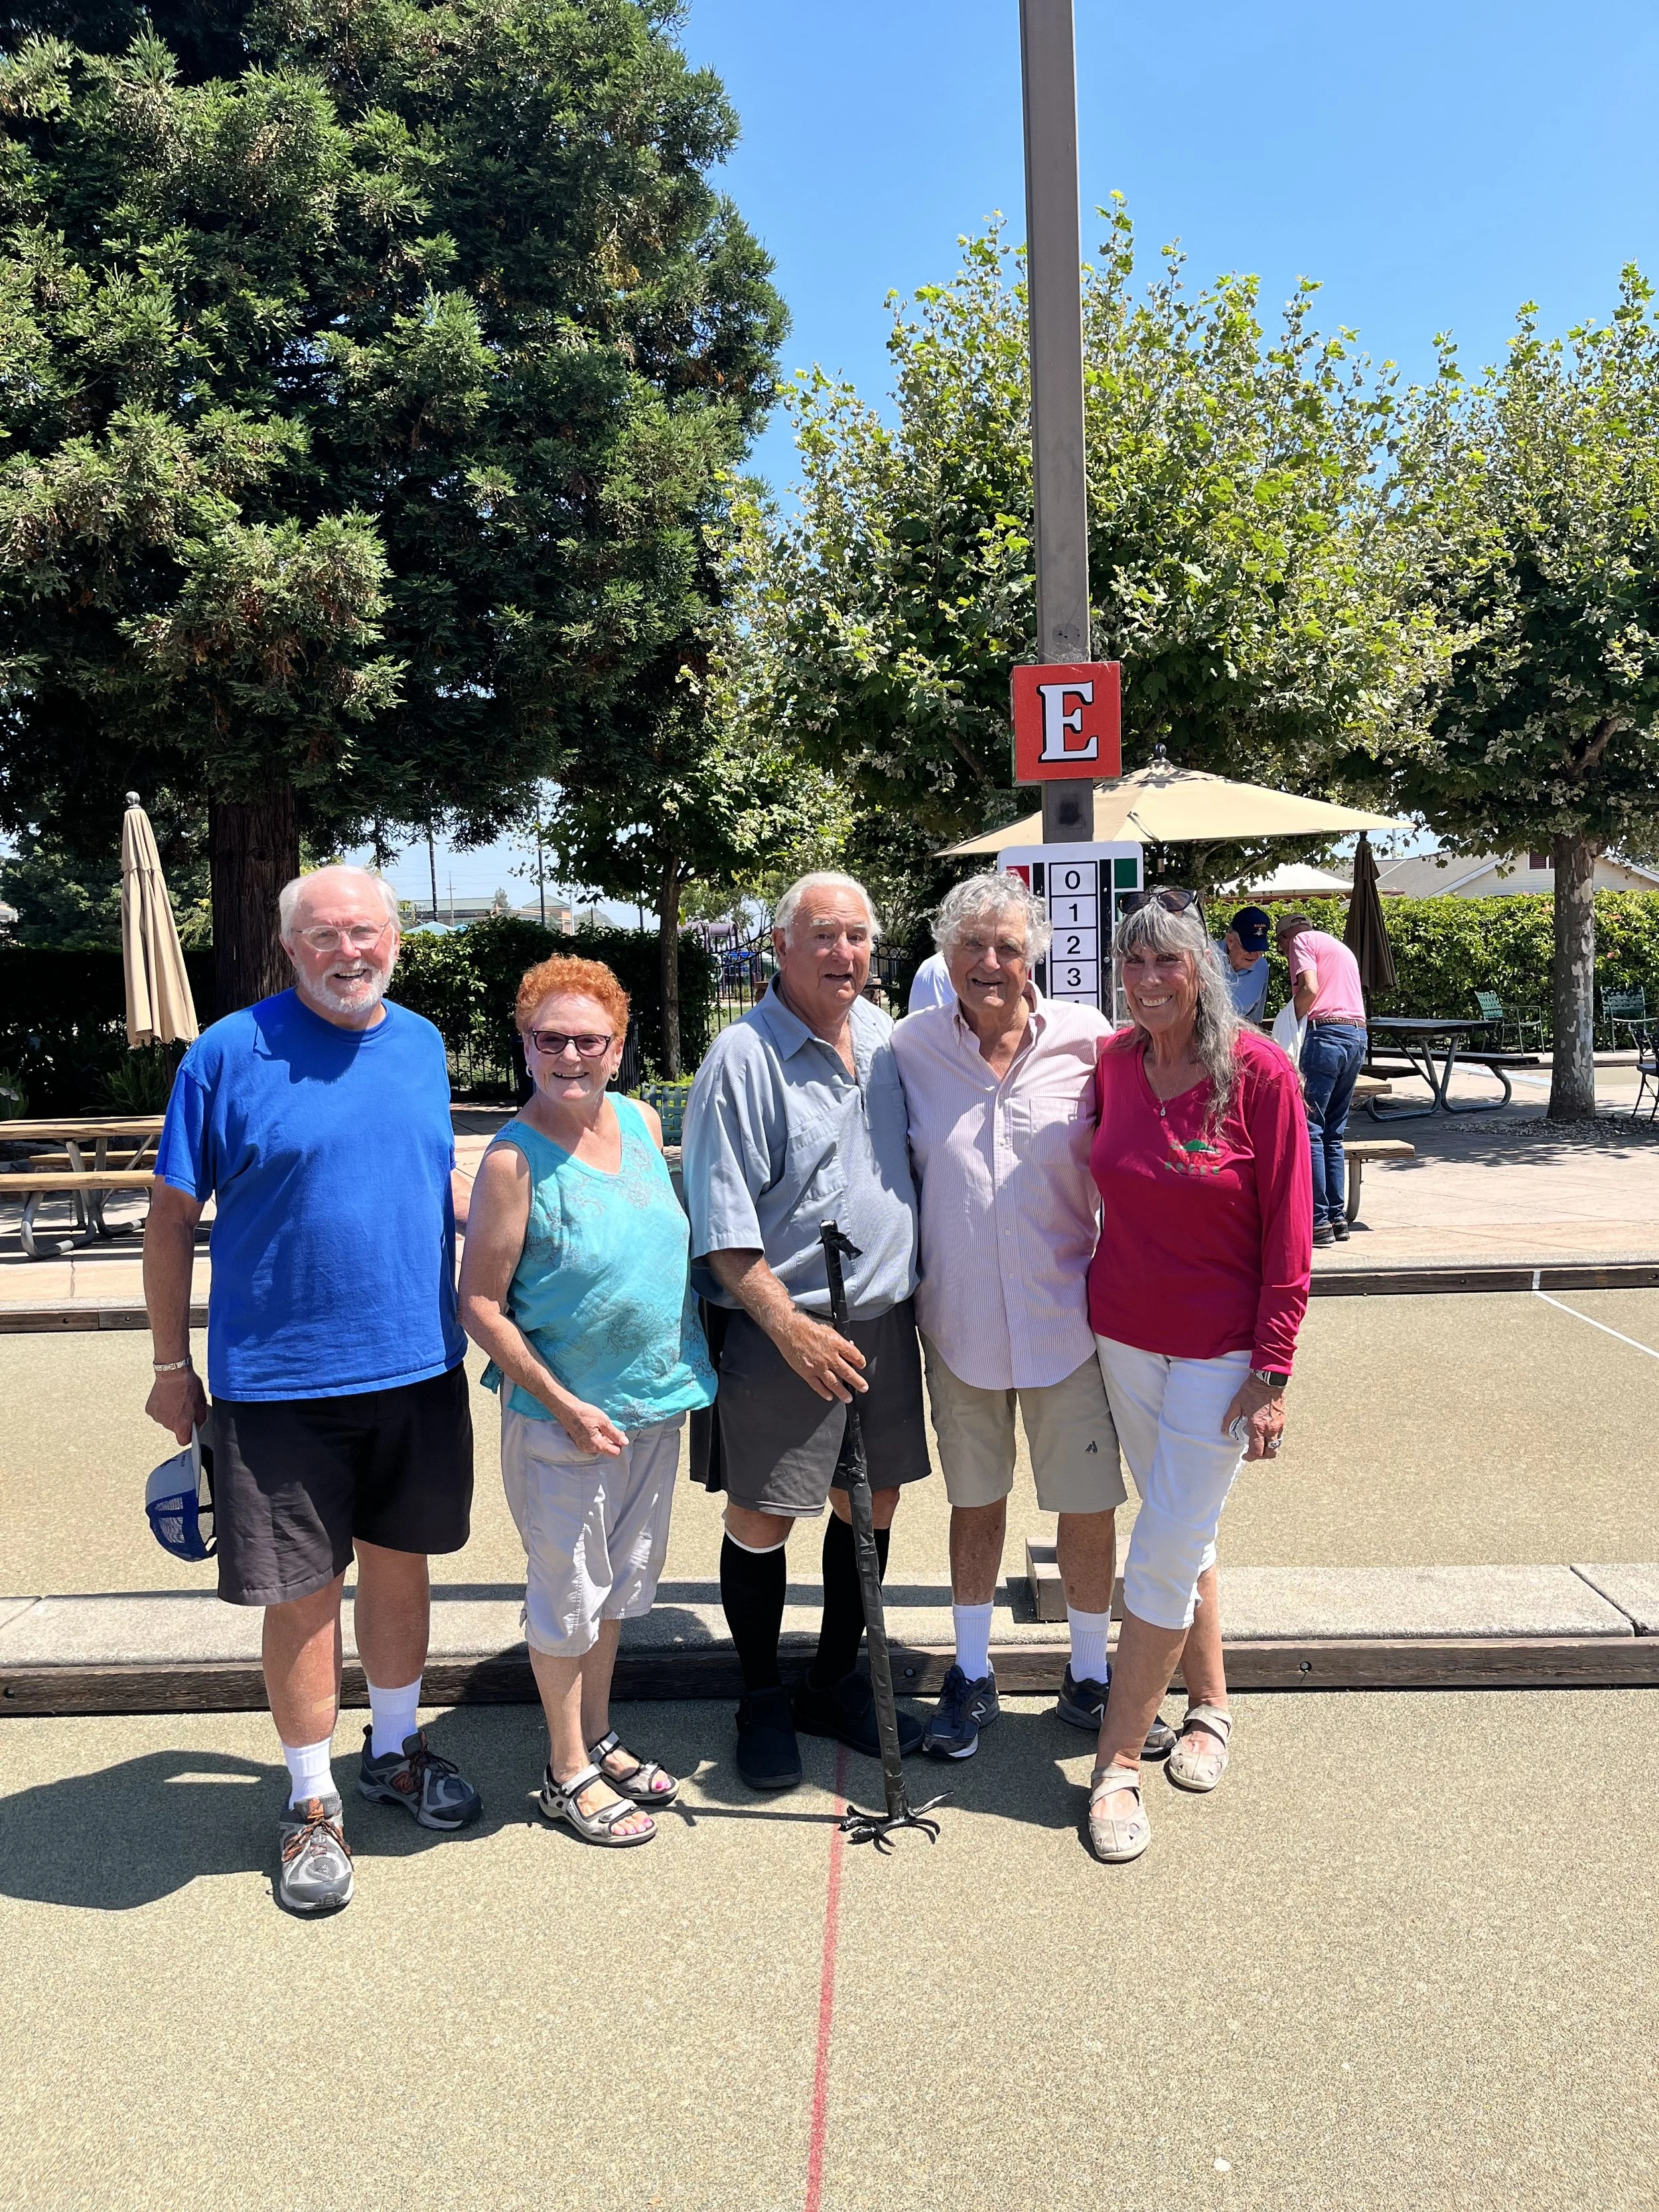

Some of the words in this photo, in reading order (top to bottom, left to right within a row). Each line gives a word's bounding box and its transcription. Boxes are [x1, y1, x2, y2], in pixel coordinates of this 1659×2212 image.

[1036, 680, 1099, 763] E
[1065, 871, 1081, 889] 0
[1068, 903, 1078, 922] 1
[1066, 936, 1081, 954] 2
[1066, 968, 1082, 987] 3
